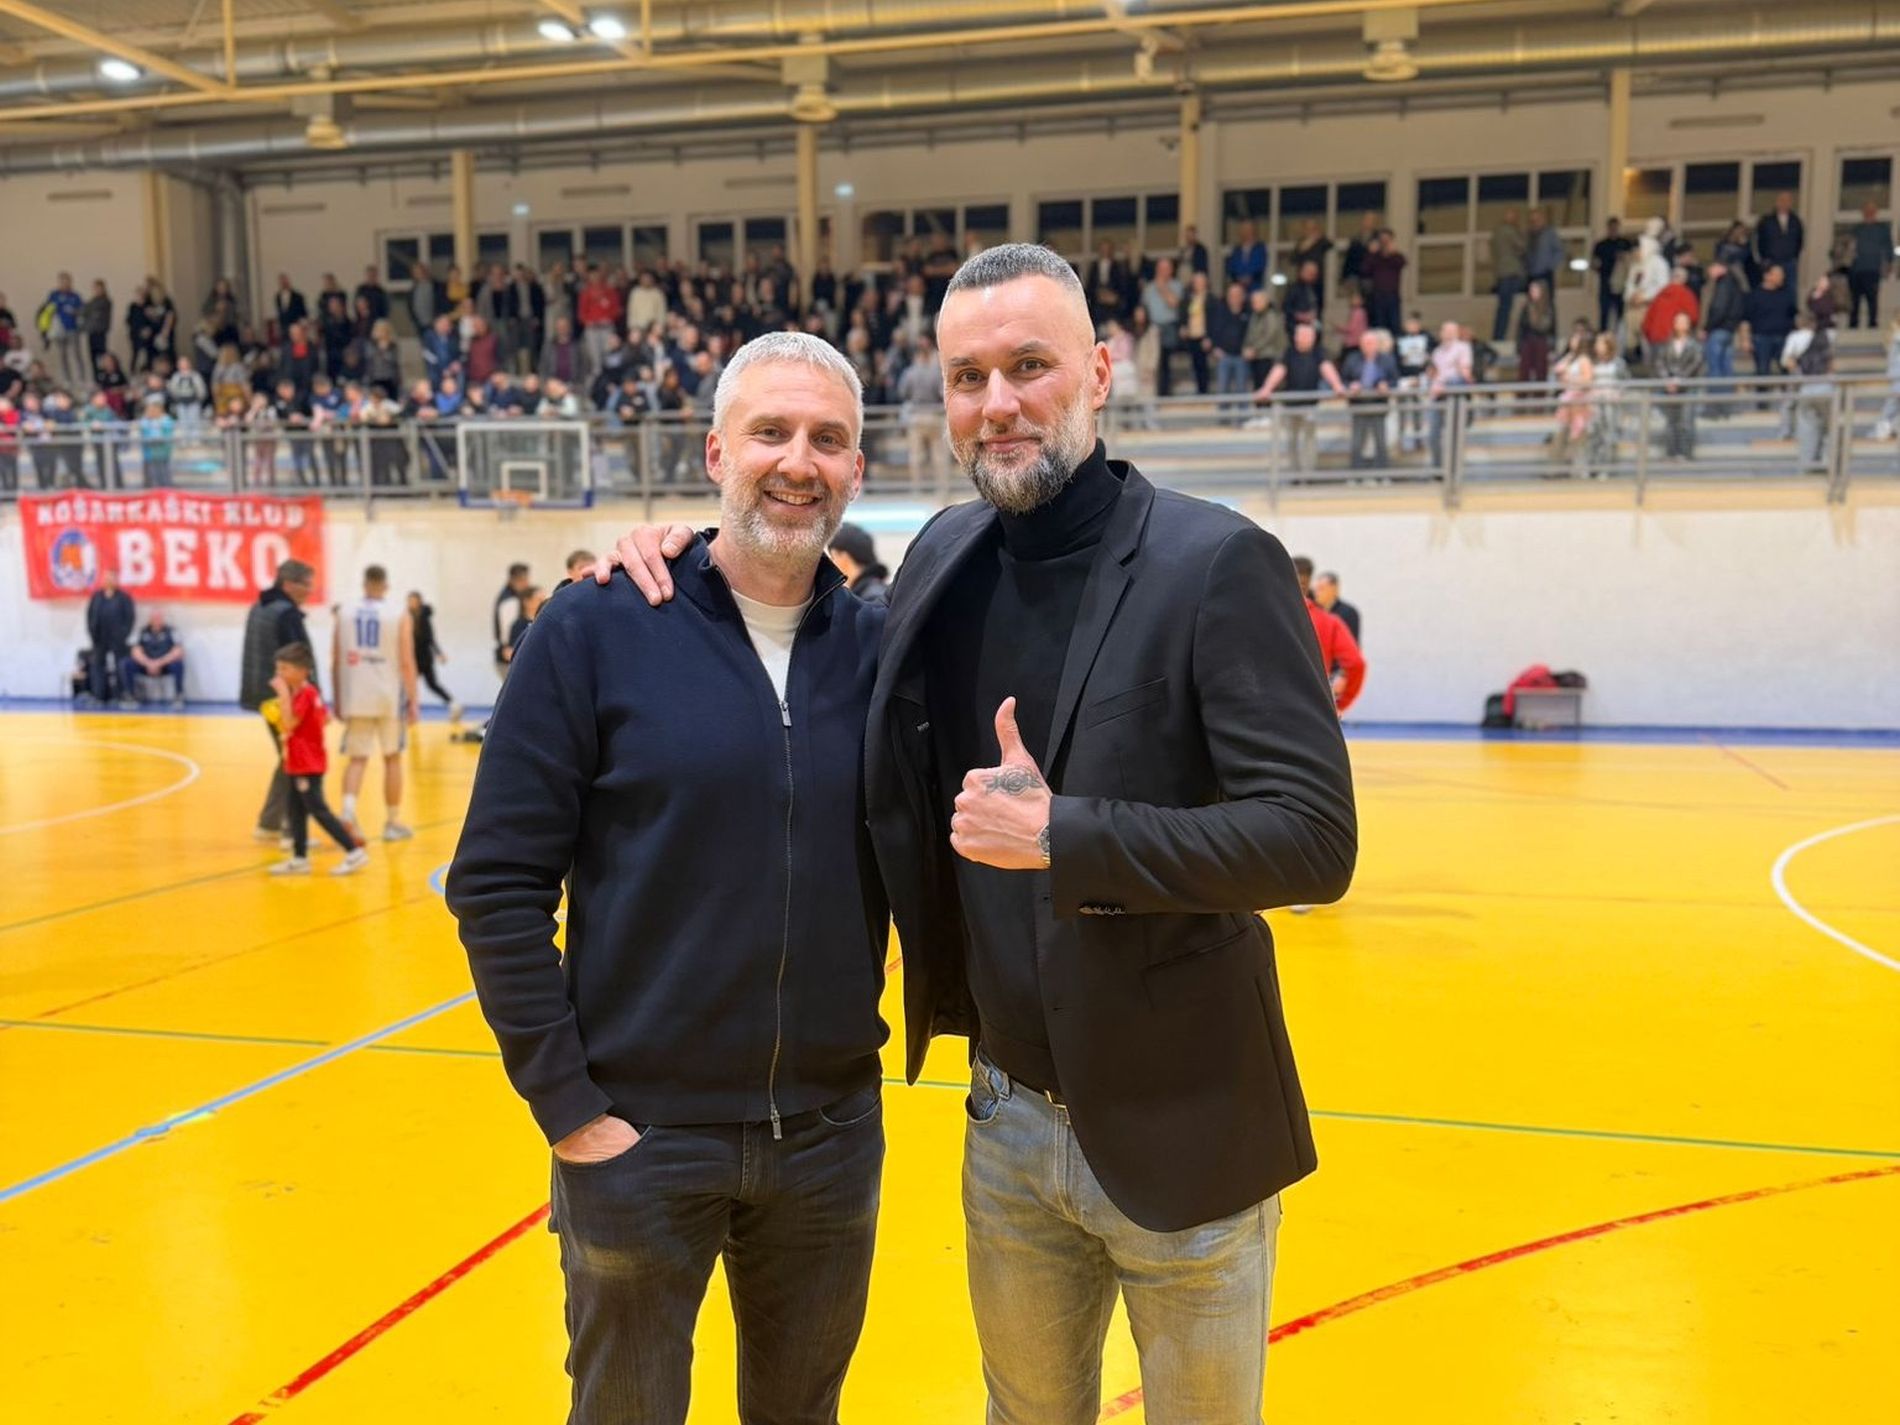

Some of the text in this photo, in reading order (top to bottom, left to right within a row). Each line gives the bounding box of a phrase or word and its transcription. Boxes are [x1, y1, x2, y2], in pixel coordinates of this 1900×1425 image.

[223, 501, 305, 528] KLUB
[116, 528, 291, 590] BEKO
[355, 617, 380, 648] 10
